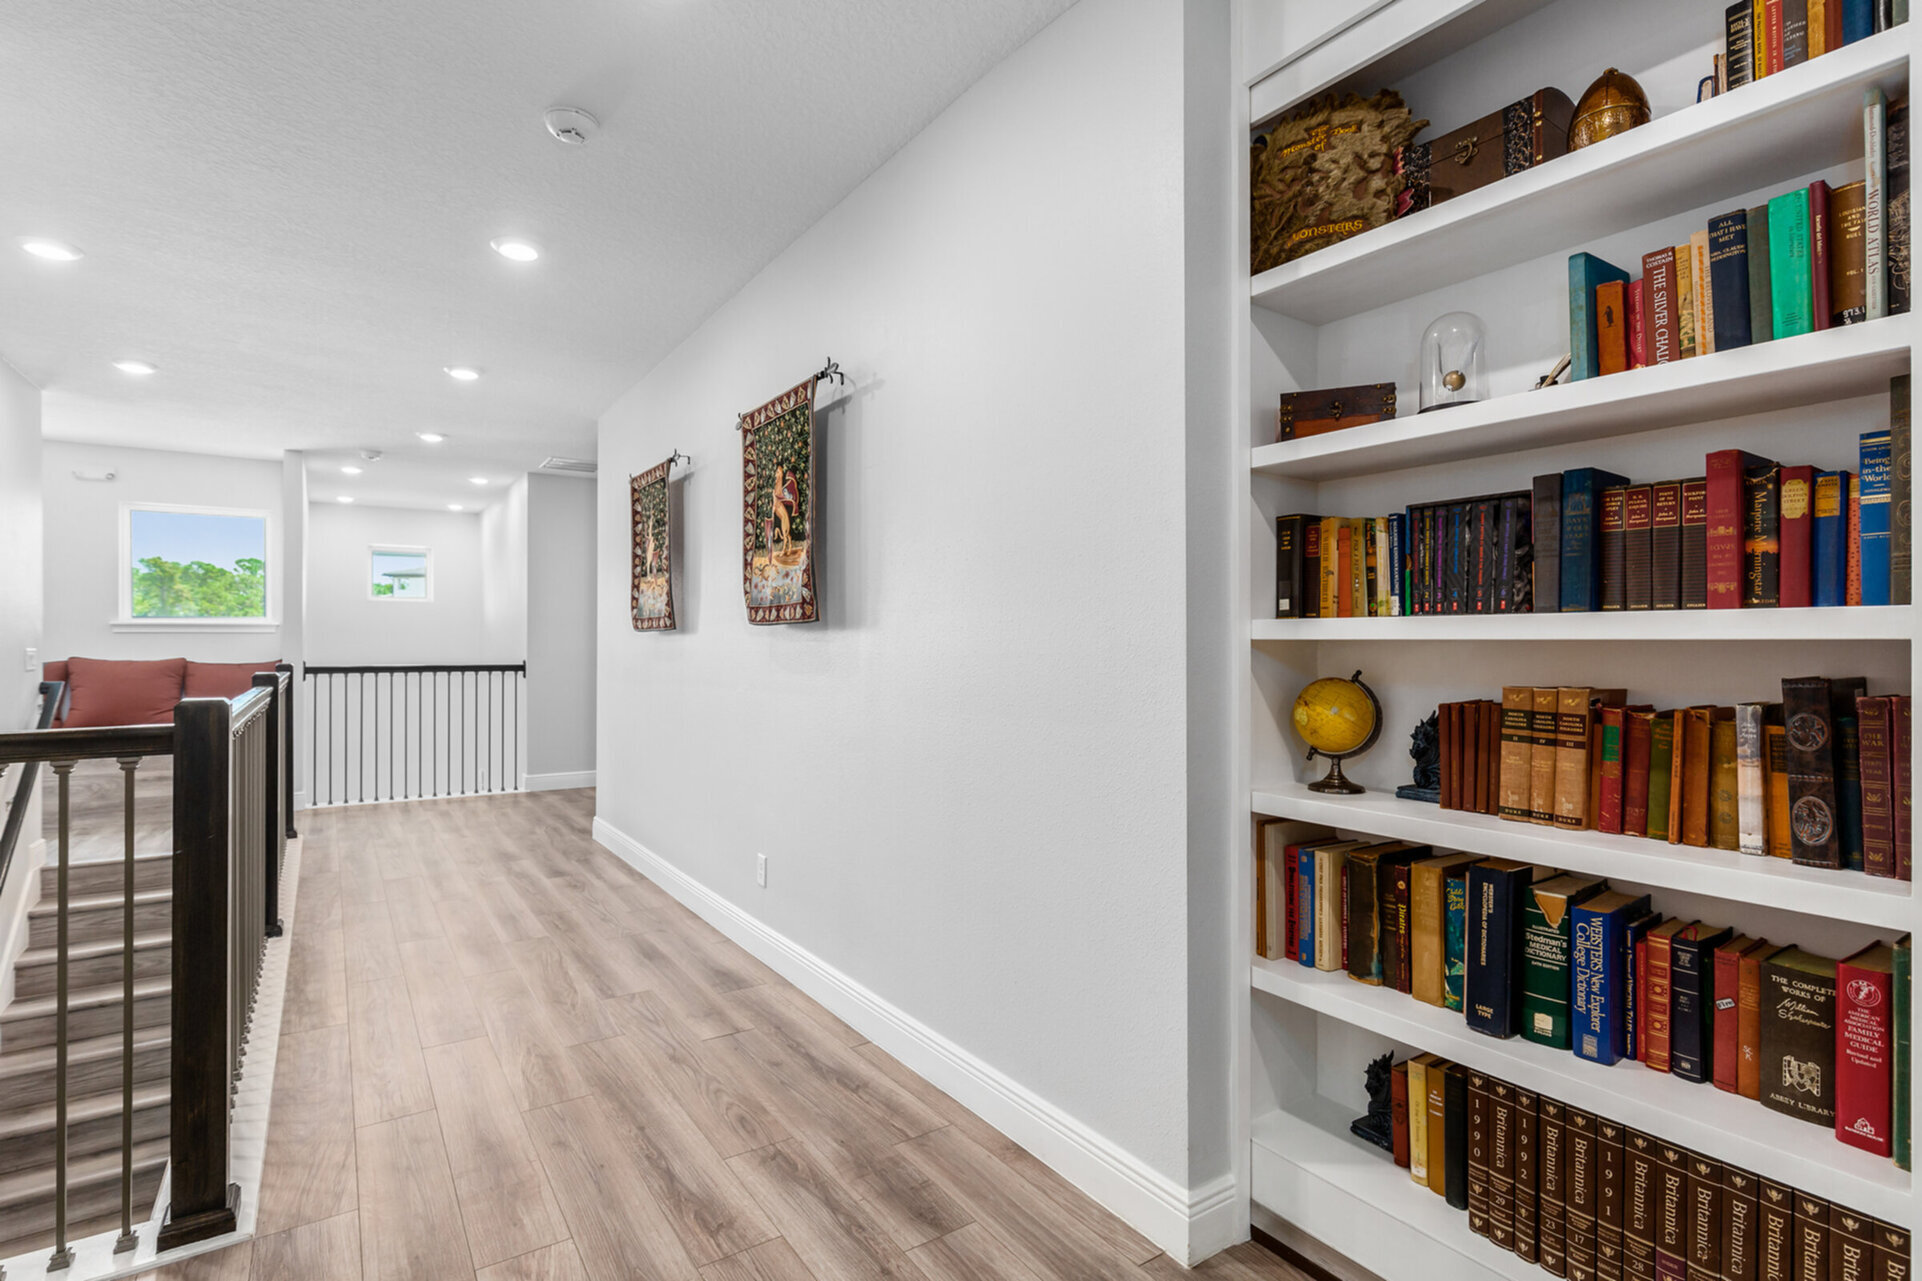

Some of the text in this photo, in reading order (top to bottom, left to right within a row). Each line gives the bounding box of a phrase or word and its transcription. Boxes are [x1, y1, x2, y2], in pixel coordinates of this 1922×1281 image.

[1867, 189, 1880, 233] WORLD
[1718, 220, 1734, 228] ALL
[1718, 233, 1735, 243] MET
[1646, 256, 1673, 269] COSTAIN
[1867, 238, 1880, 275] ATLAS
[1653, 266, 1666, 290] THE
[1654, 291, 1668, 328] SILVER
[1750, 491, 1767, 532] Marjorie
[1749, 535, 1767, 596] Mrningstar
[1862, 740, 1884, 748] WAR
[1398, 904, 1406, 934] Pirates
[1525, 932, 1568, 948] Stedman's
[1529, 941, 1562, 954] MEDICAL
[1525, 946, 1567, 962] DICTIONARY
[1574, 922, 1591, 1014] College Dictionary
[1590, 972, 1605, 994] New
[1771, 974, 1788, 985] THE
[1781, 985, 1826, 1002] WORKS OF
[1475, 1003, 1494, 1014] LARGE
[1478, 1010, 1492, 1020] TYPE
[1588, 994, 1606, 1033] Explorer
[1848, 1010, 1880, 1022] AMERICAN
[1844, 1018, 1884, 1032] ASSOCIATION
[1850, 1014, 1877, 1026] MEDICAL
[1844, 1032, 1884, 1048] MEDICAL
[1848, 1025, 1880, 1039] FAMILY
[1850, 1040, 1878, 1053] GUIDE
[1850, 1056, 1877, 1068] Updated
[1770, 1092, 1836, 1118] ABBEY LIBRARY
[1496, 1106, 1508, 1169] Britannica
[1546, 1125, 1559, 1191] Britannica
[1575, 1137, 1588, 1204] Britannica
[1495, 1196, 1506, 1206] 29
[1634, 1160, 1648, 1230] Britannica
[1665, 1172, 1680, 1245] Britannica
[1546, 1218, 1556, 1230] 23
[1697, 1186, 1712, 1262] Britannica
[1575, 1234, 1585, 1244] 17
[1732, 1200, 1748, 1274] Britannica
[1632, 1259, 1644, 1272] 28
